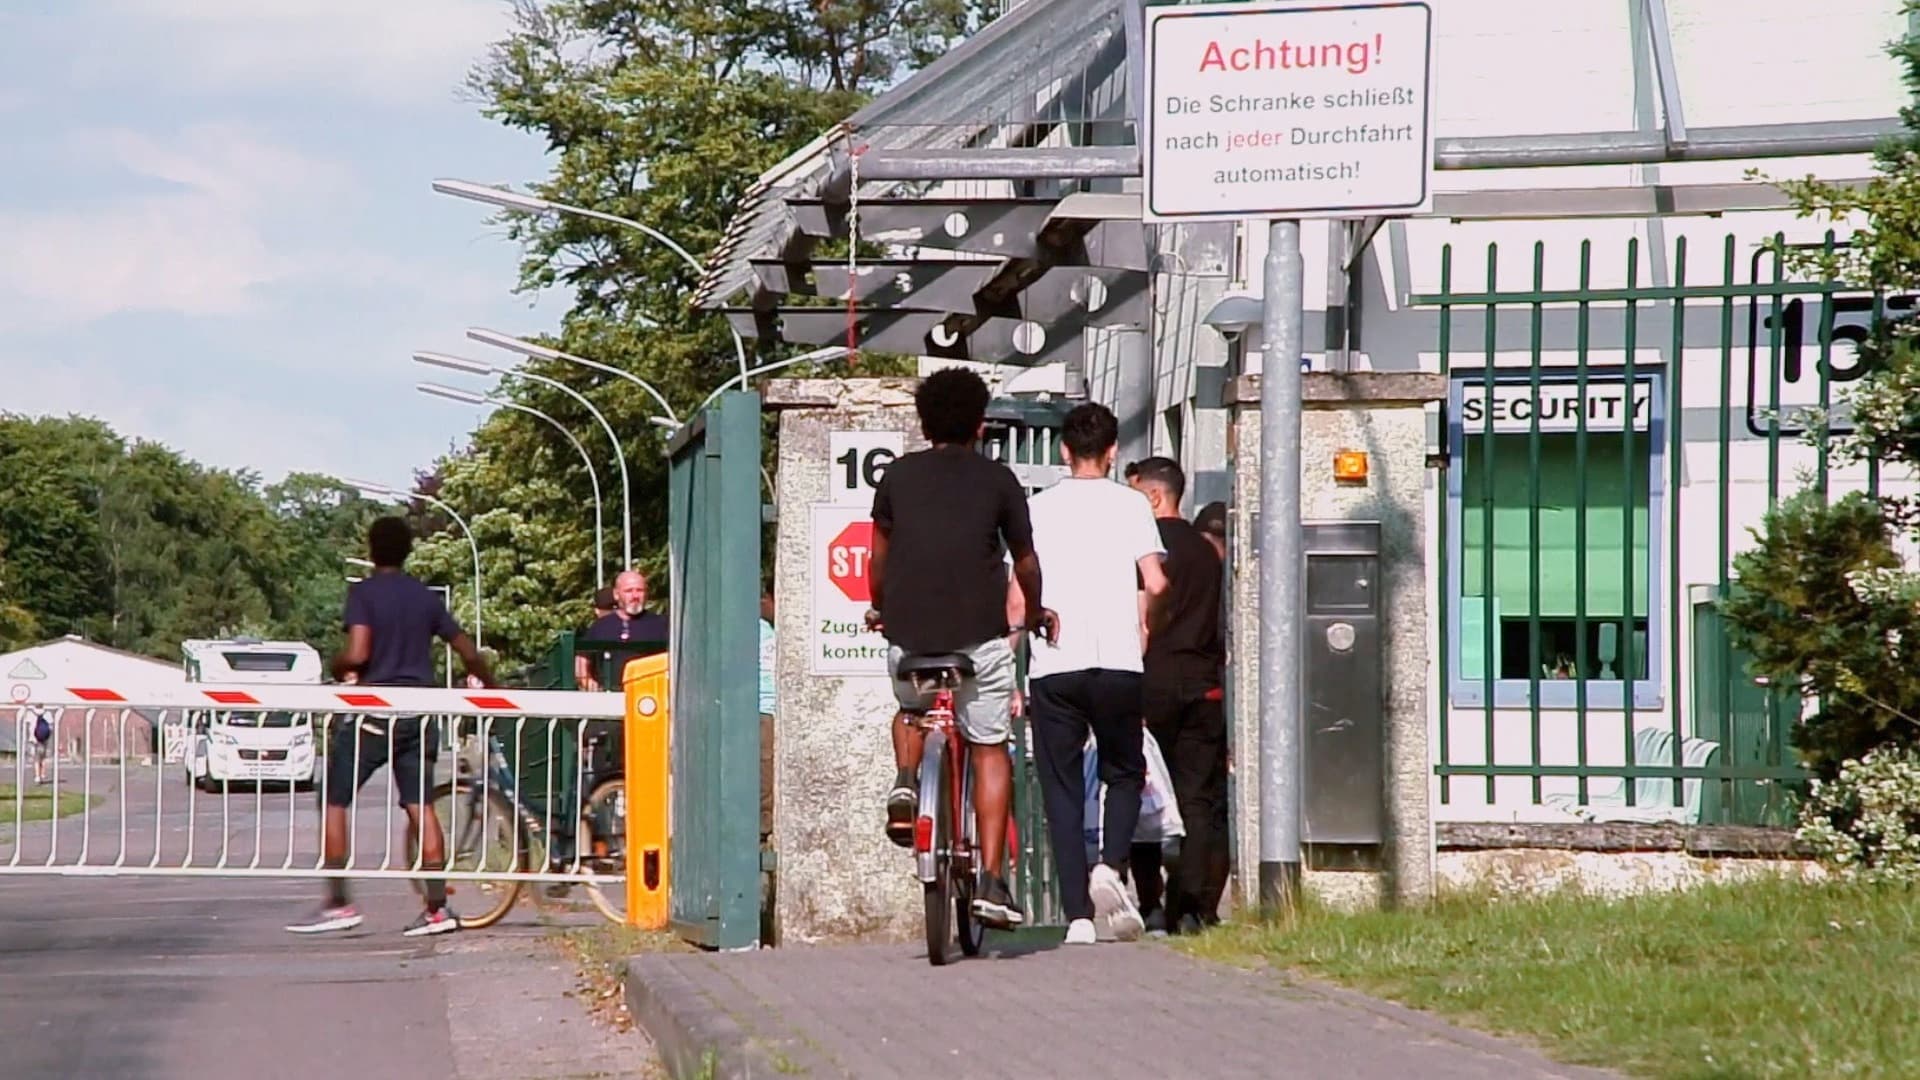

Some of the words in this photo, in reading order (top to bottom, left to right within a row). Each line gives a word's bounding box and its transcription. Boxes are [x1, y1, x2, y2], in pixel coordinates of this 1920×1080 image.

[1199, 33, 1383, 74] Achtung!
[1166, 96, 1201, 115] Die
[1209, 92, 1316, 113] Schranke
[1323, 87, 1414, 108] schließt
[1166, 132, 1219, 150] nach
[1225, 130, 1283, 152] jeder
[1290, 124, 1413, 146] Durchfahrt
[1213, 161, 1361, 184] automatisch!
[1763, 295, 1920, 384] 15
[1463, 396, 1648, 422] SECURITY
[836, 447, 897, 489] 16
[832, 545, 872, 578] ST
[820, 619, 871, 639] Zuga
[822, 643, 889, 659] kontro
